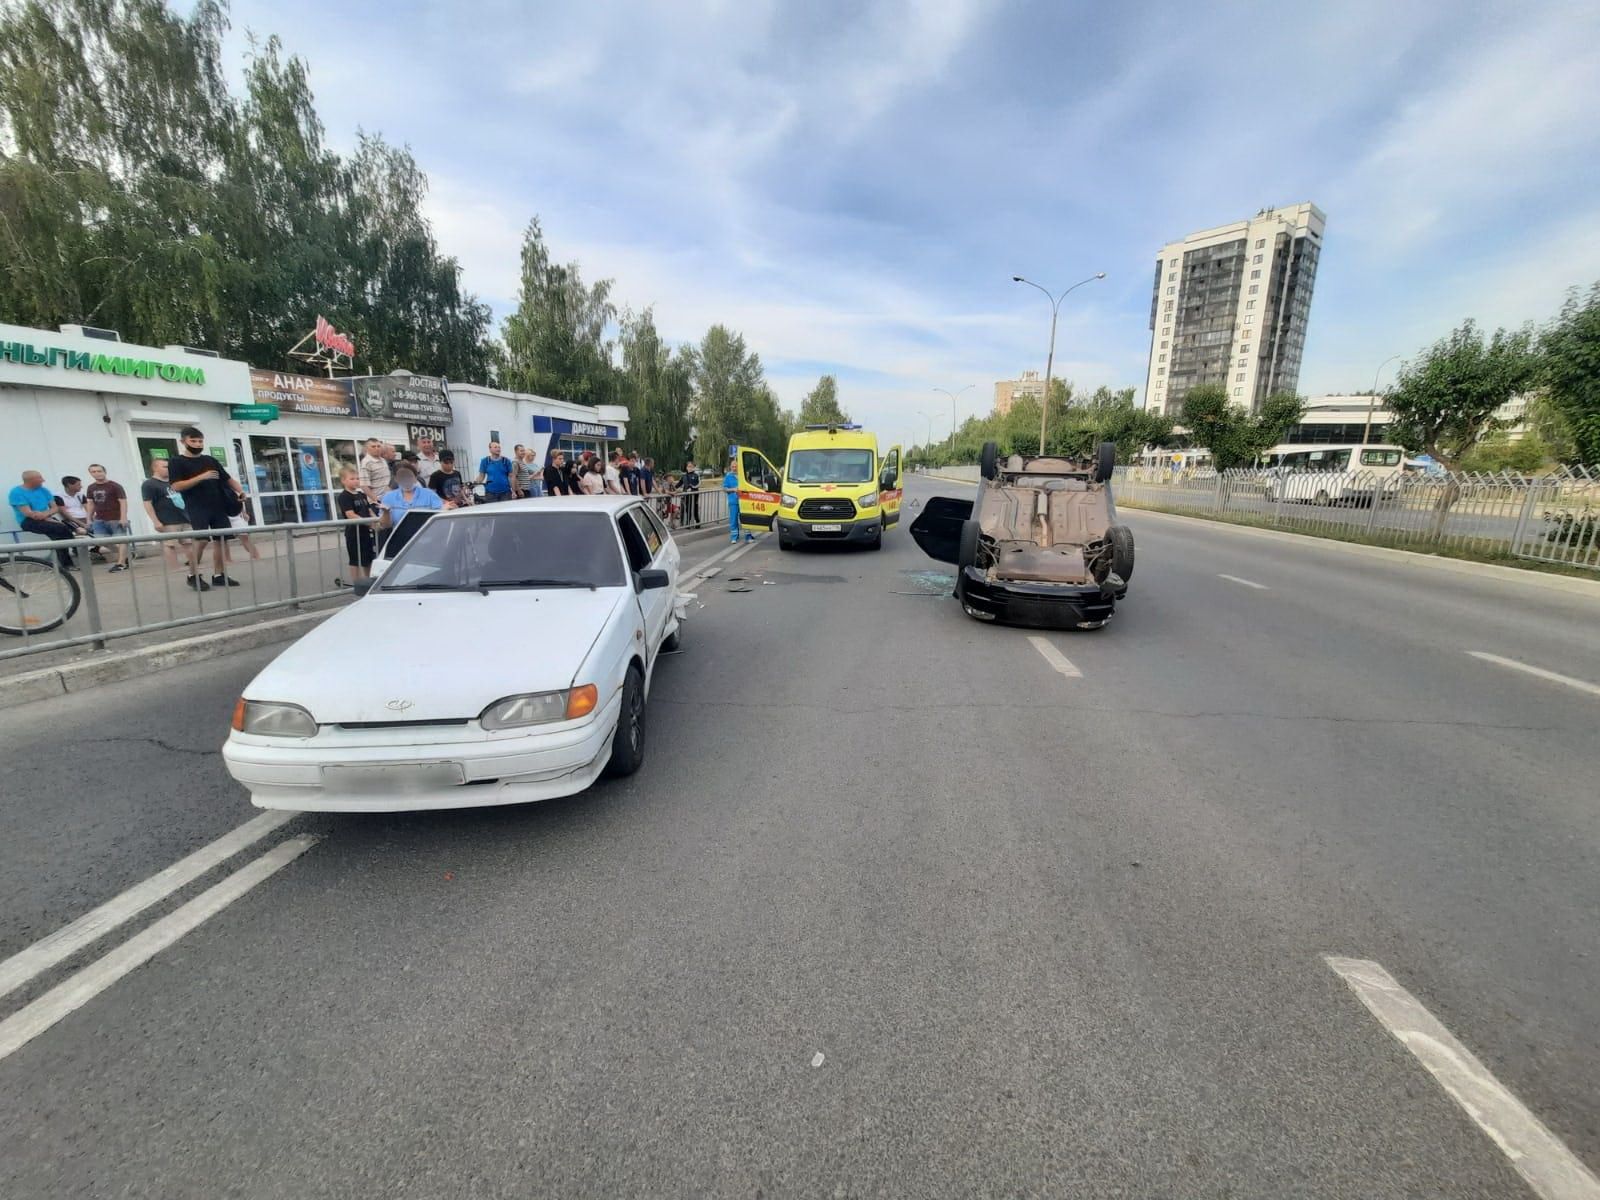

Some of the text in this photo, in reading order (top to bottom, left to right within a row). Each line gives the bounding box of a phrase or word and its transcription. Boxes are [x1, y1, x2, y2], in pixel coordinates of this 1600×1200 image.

[274, 374, 313, 391] АНАР
[258, 390, 305, 402] ПРОДУКТЫ
[410, 426, 445, 441] РОЗЫ
